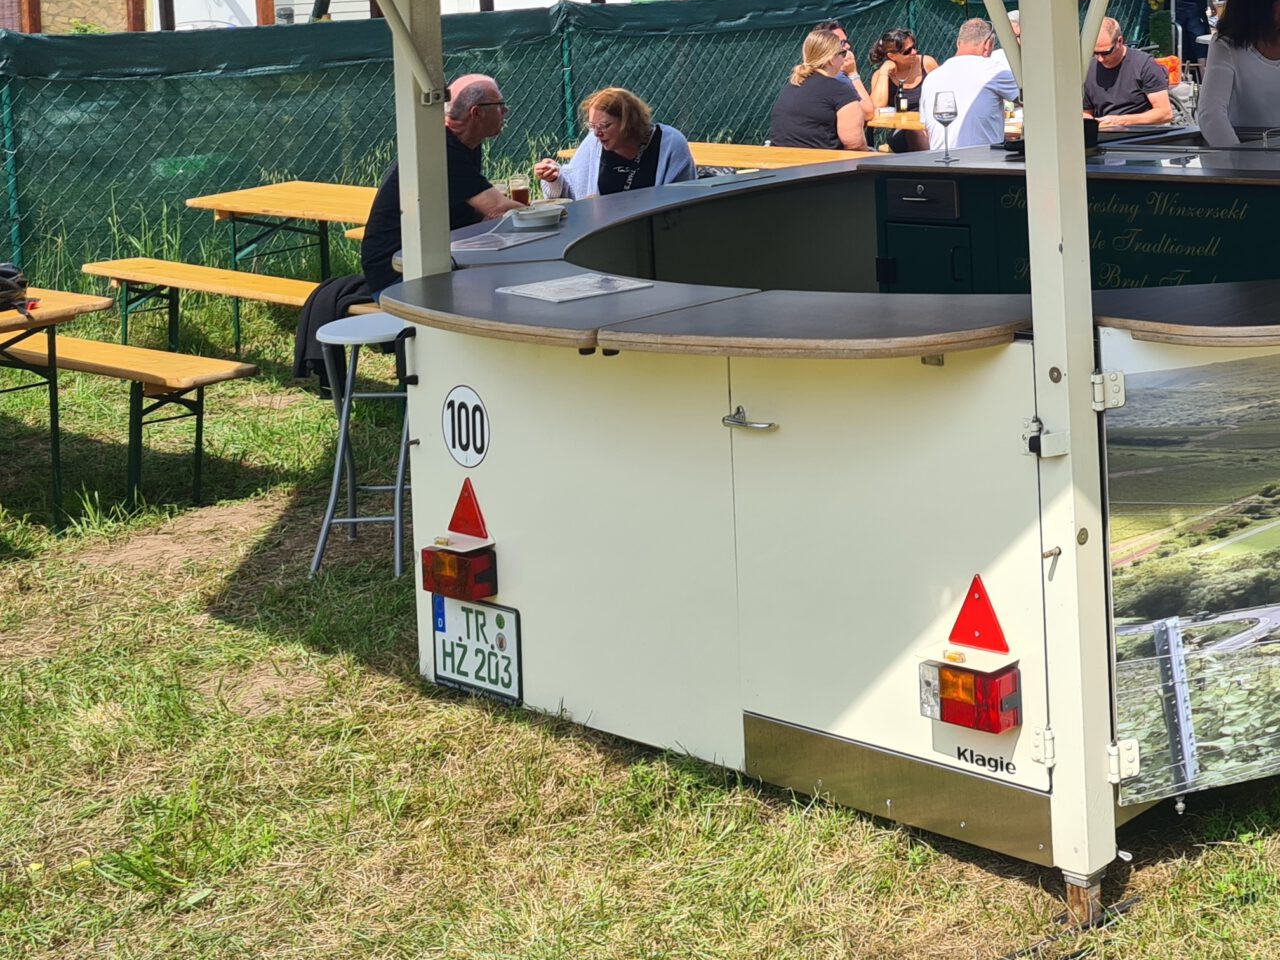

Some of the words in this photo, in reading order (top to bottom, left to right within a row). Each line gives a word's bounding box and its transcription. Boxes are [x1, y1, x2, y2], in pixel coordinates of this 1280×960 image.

[1147, 191, 1249, 221] Winzersekt
[446, 400, 485, 455] 100
[461, 606, 489, 644] TR
[442, 639, 469, 677] HZ
[474, 647, 512, 689] 203
[957, 746, 1016, 774] Klagie
